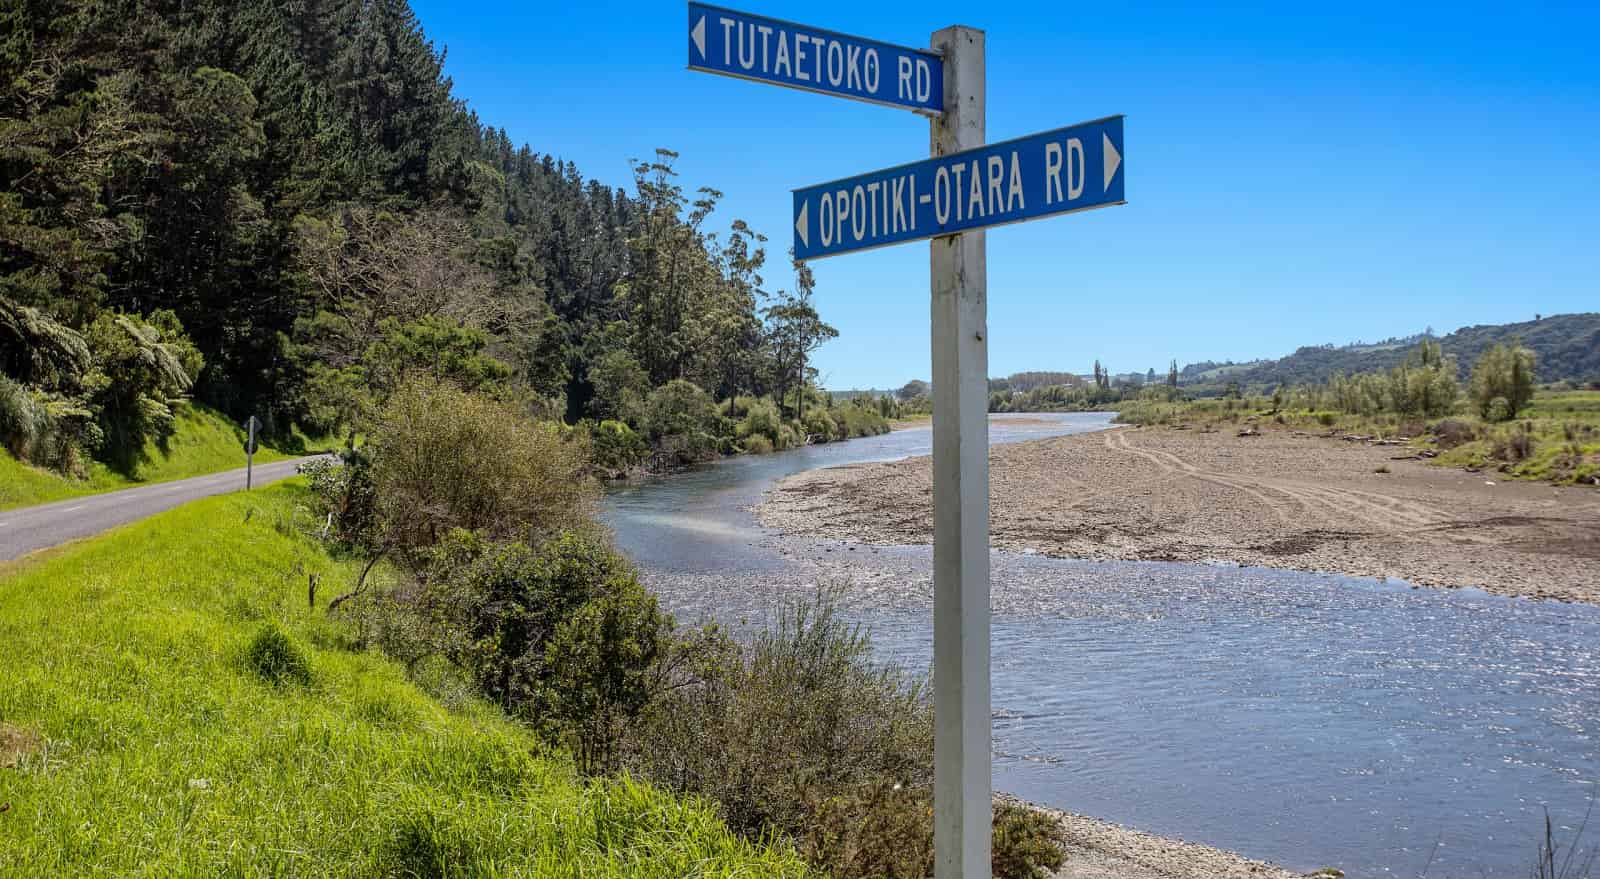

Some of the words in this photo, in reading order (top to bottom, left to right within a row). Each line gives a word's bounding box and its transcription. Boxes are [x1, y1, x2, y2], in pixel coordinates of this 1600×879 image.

[720, 17, 880, 94] TUTAETOKO
[898, 55, 931, 103] RD
[819, 151, 1025, 248] OPOTIKI-OTARA
[1045, 137, 1085, 204] RD
